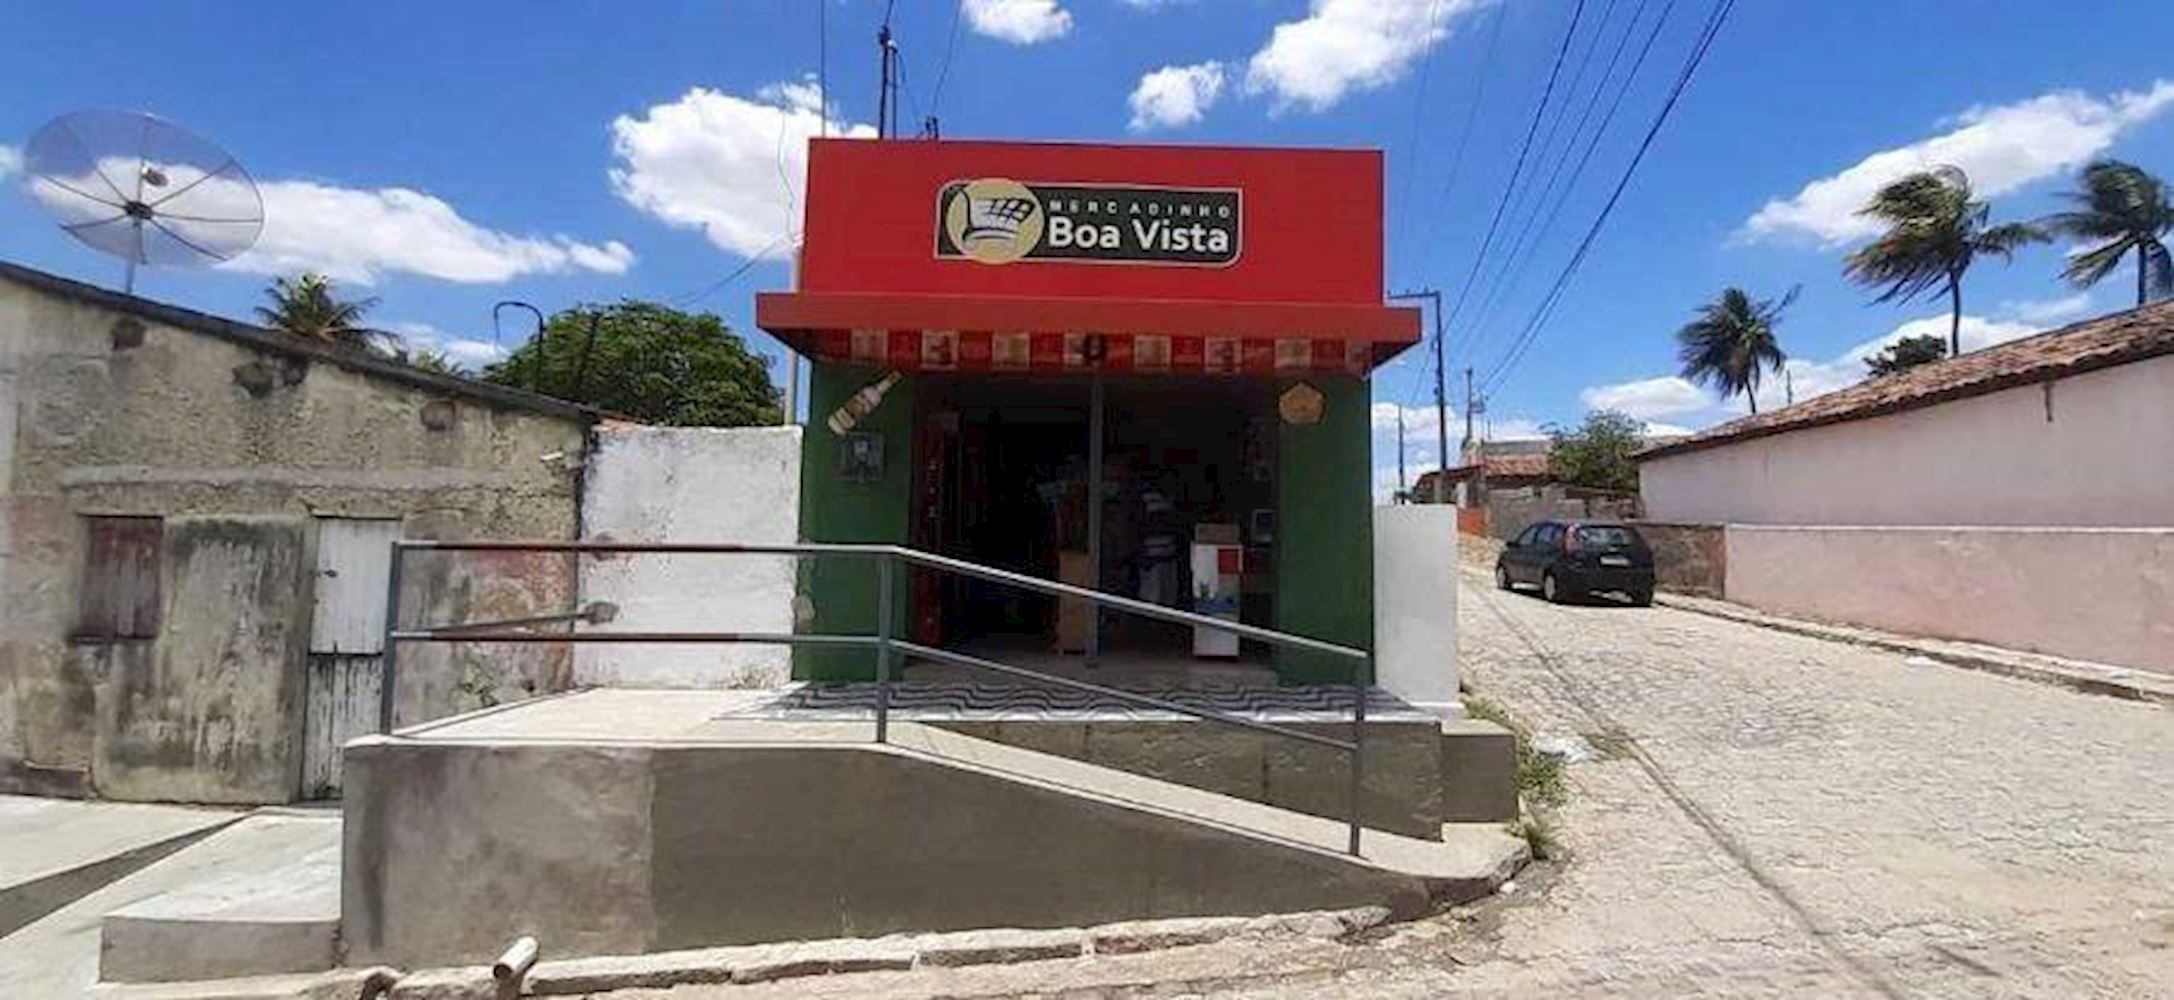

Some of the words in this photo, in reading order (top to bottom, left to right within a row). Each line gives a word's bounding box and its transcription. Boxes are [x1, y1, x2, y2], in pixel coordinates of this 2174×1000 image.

[1050, 200, 1230, 218] MERCADINHO
[1049, 216, 1121, 248] Boa
[1131, 218, 1229, 252] Vista
